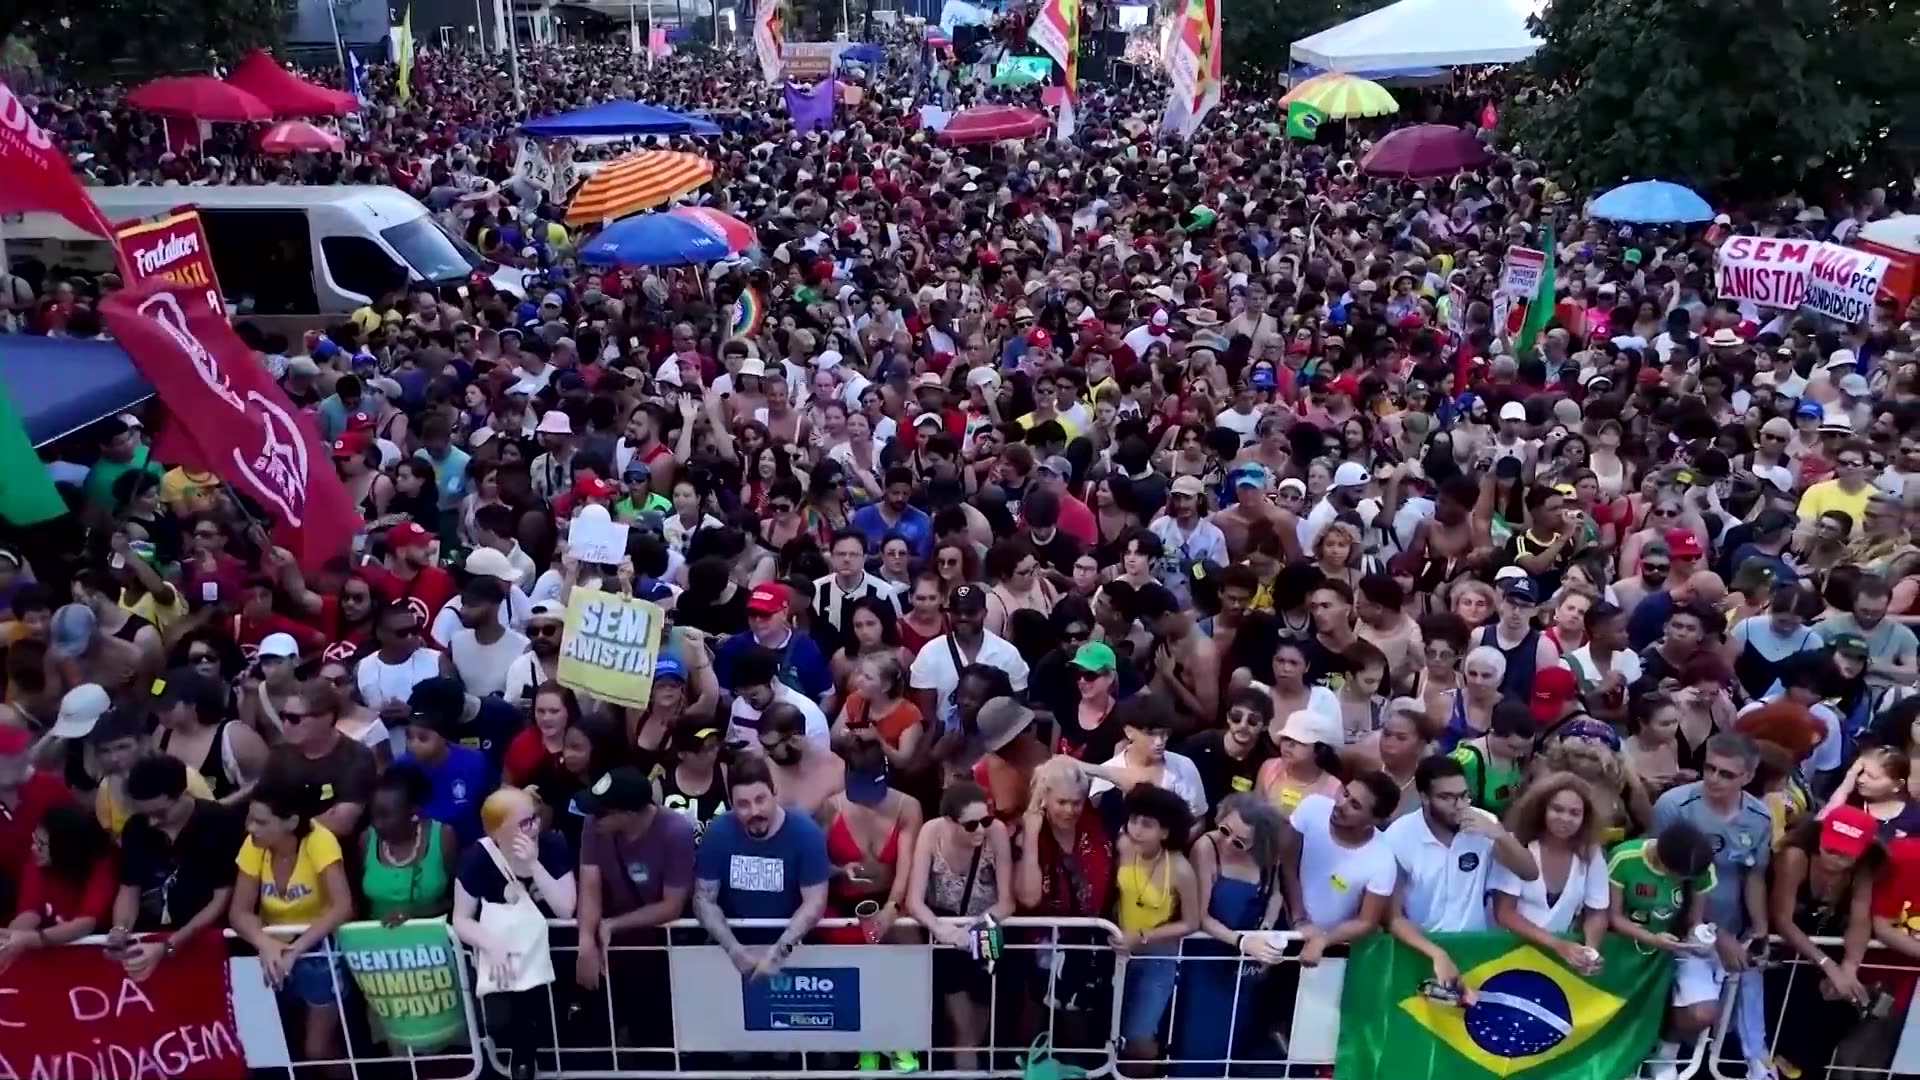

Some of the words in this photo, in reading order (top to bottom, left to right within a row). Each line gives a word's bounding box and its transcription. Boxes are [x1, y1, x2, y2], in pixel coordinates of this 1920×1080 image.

[1727, 238, 1809, 263] SEM
[1720, 265, 1805, 305] ANISTIA
[1851, 271, 1877, 295] PEC
[580, 602, 651, 648] SEM
[562, 637, 651, 677] ANISTIA
[346, 944, 448, 971] CENTRÃO
[795, 975, 834, 992] Rio
[68, 977, 155, 1021] DA
[393, 989, 458, 1018] POVO
